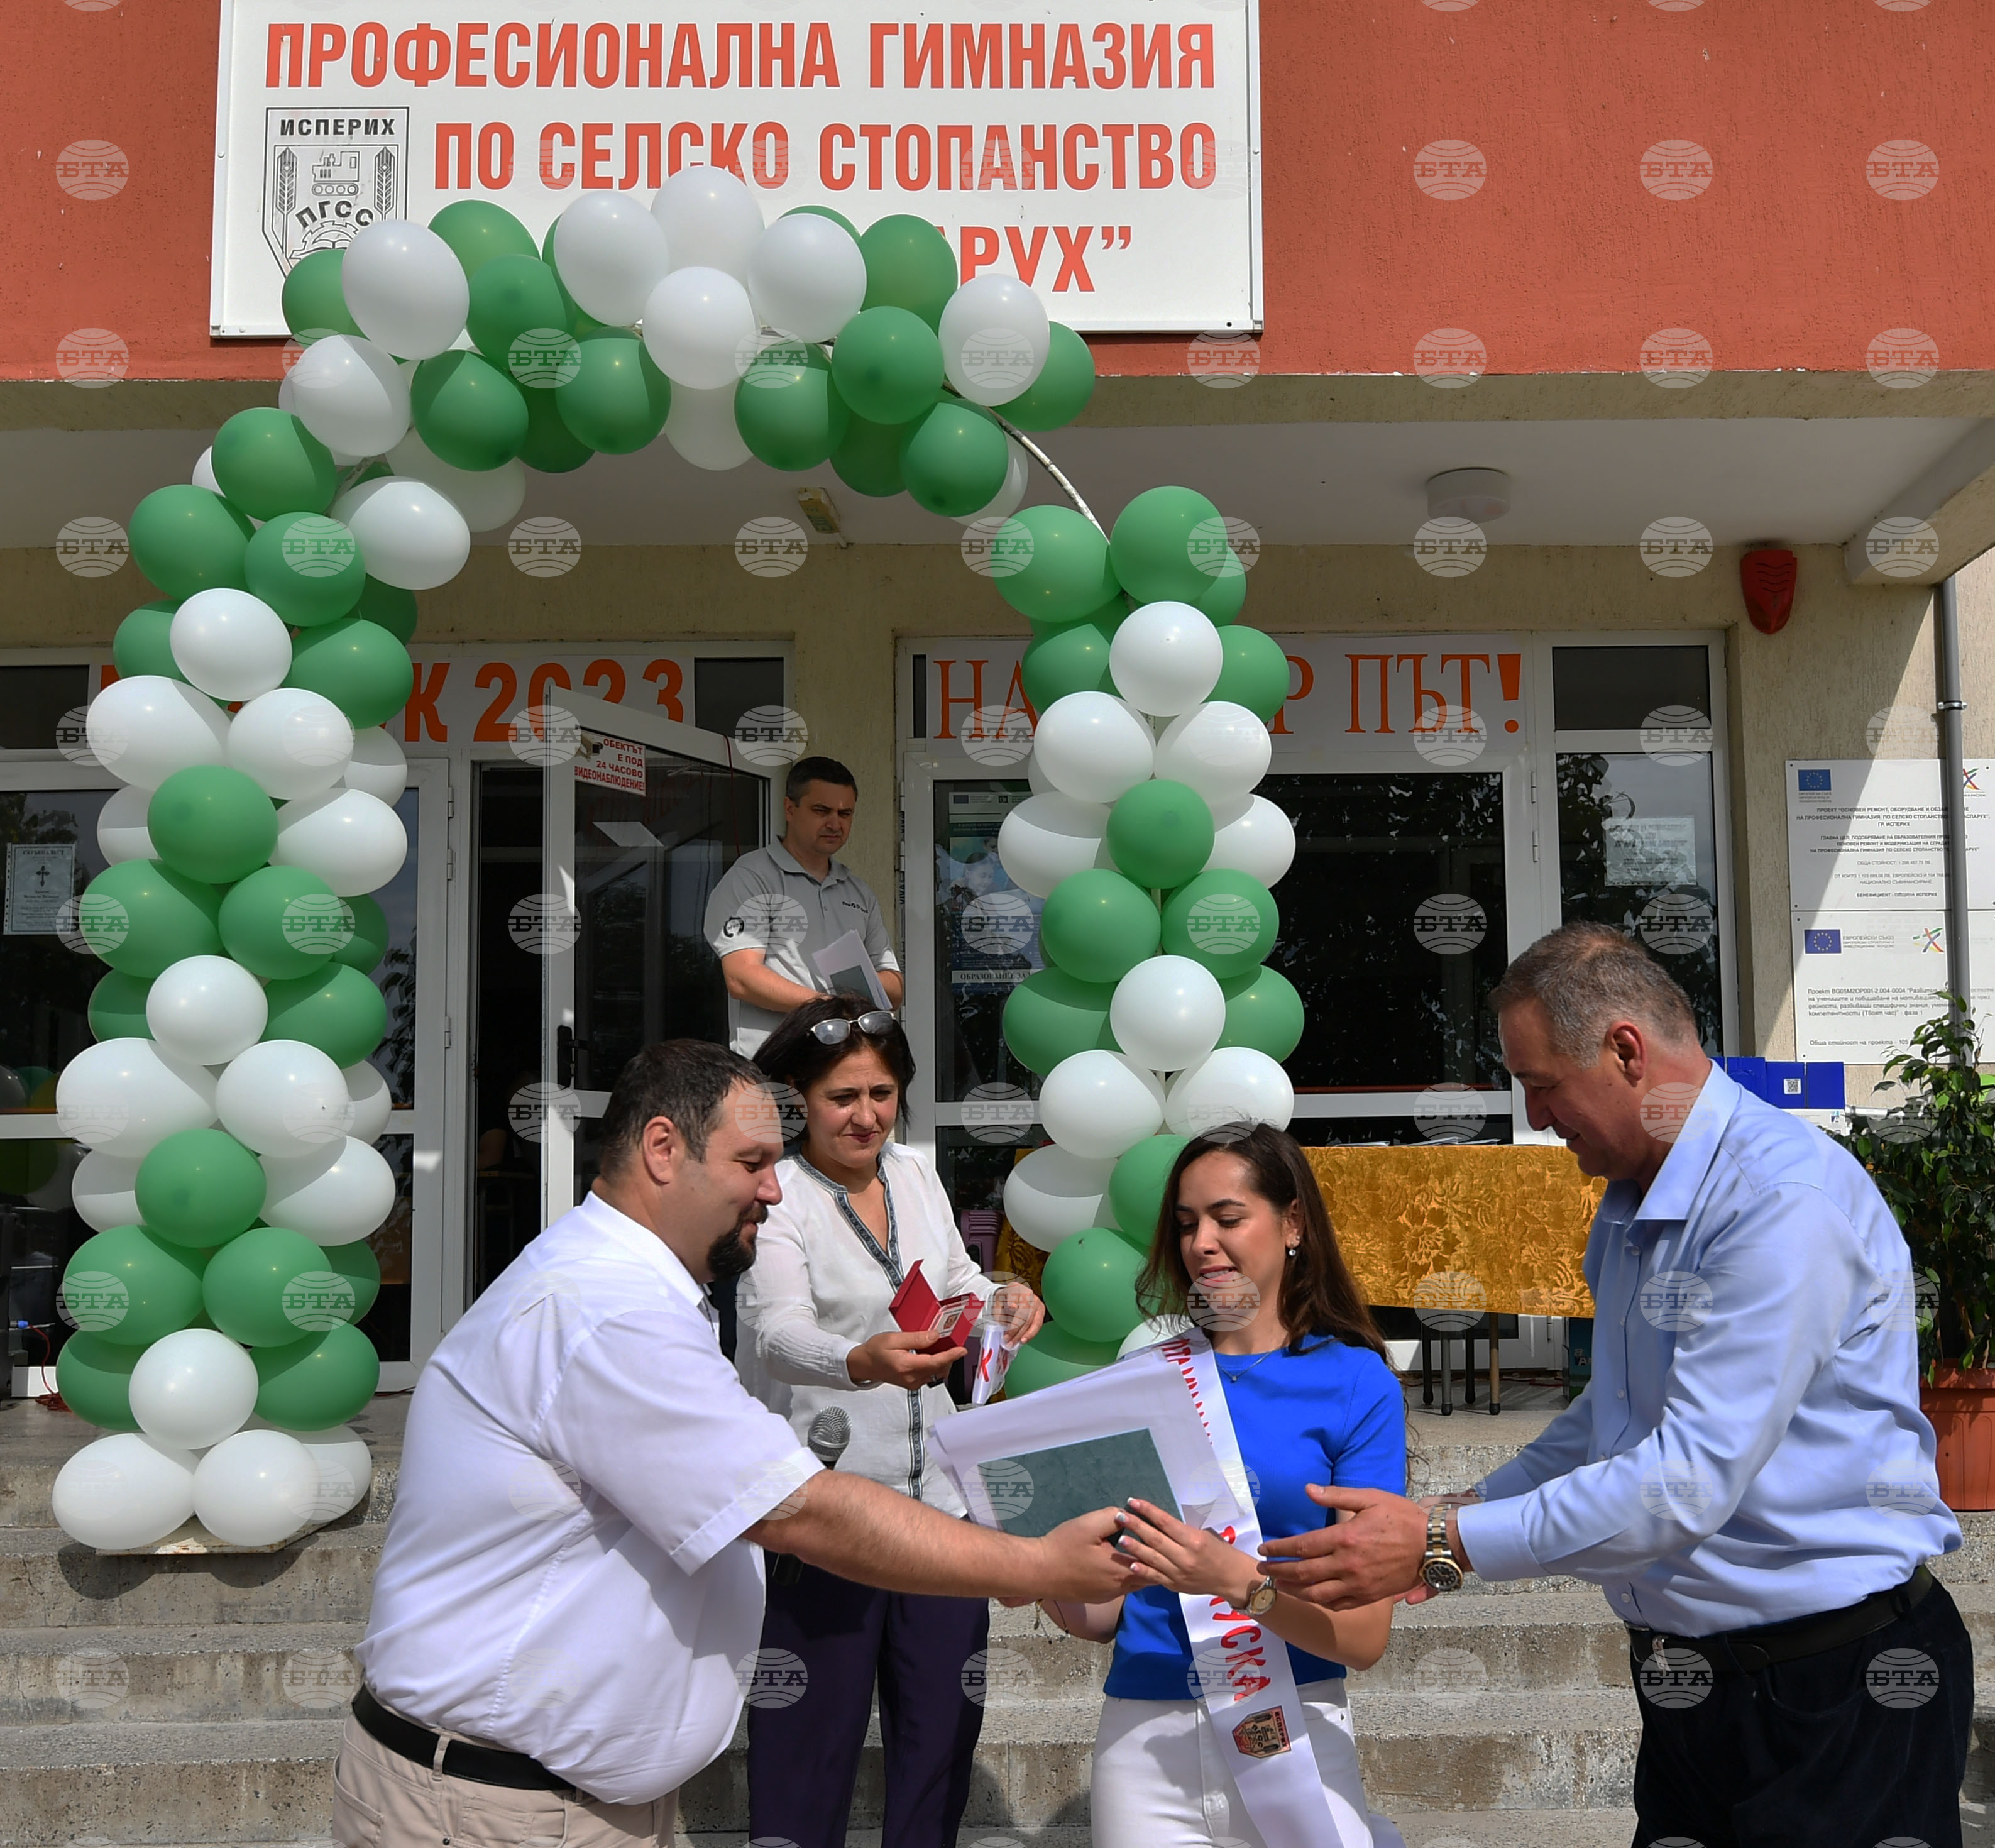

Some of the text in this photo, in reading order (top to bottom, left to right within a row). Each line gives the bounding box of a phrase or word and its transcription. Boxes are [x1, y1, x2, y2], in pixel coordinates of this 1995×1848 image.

[265, 21, 1214, 89] ПРОФЕСИОНАЛНА ГИМНАЗИЯ
[280, 117, 395, 137] ИСПЕРИХ
[435, 121, 1216, 191] ПО СЕЛСКО СТОПАНСТВО
[296, 199, 374, 229] ПГСС
[945, 225, 1133, 293] РУХ”
[473, 658, 684, 744] 2023
[933, 659, 1038, 739] НА
[1344, 653, 1522, 734] ПЪТ!
[603, 738, 644, 755] ОБЕКТЪТ
[617, 754, 644, 769] Е ПОД
[574, 766, 645, 791] ВИДЕОНАБЛЮДЕНИЕ!
[596, 760, 644, 778] 24 ЧАСОВО
[960, 972, 1014, 981] ОБРАЗОВАНИЕ
